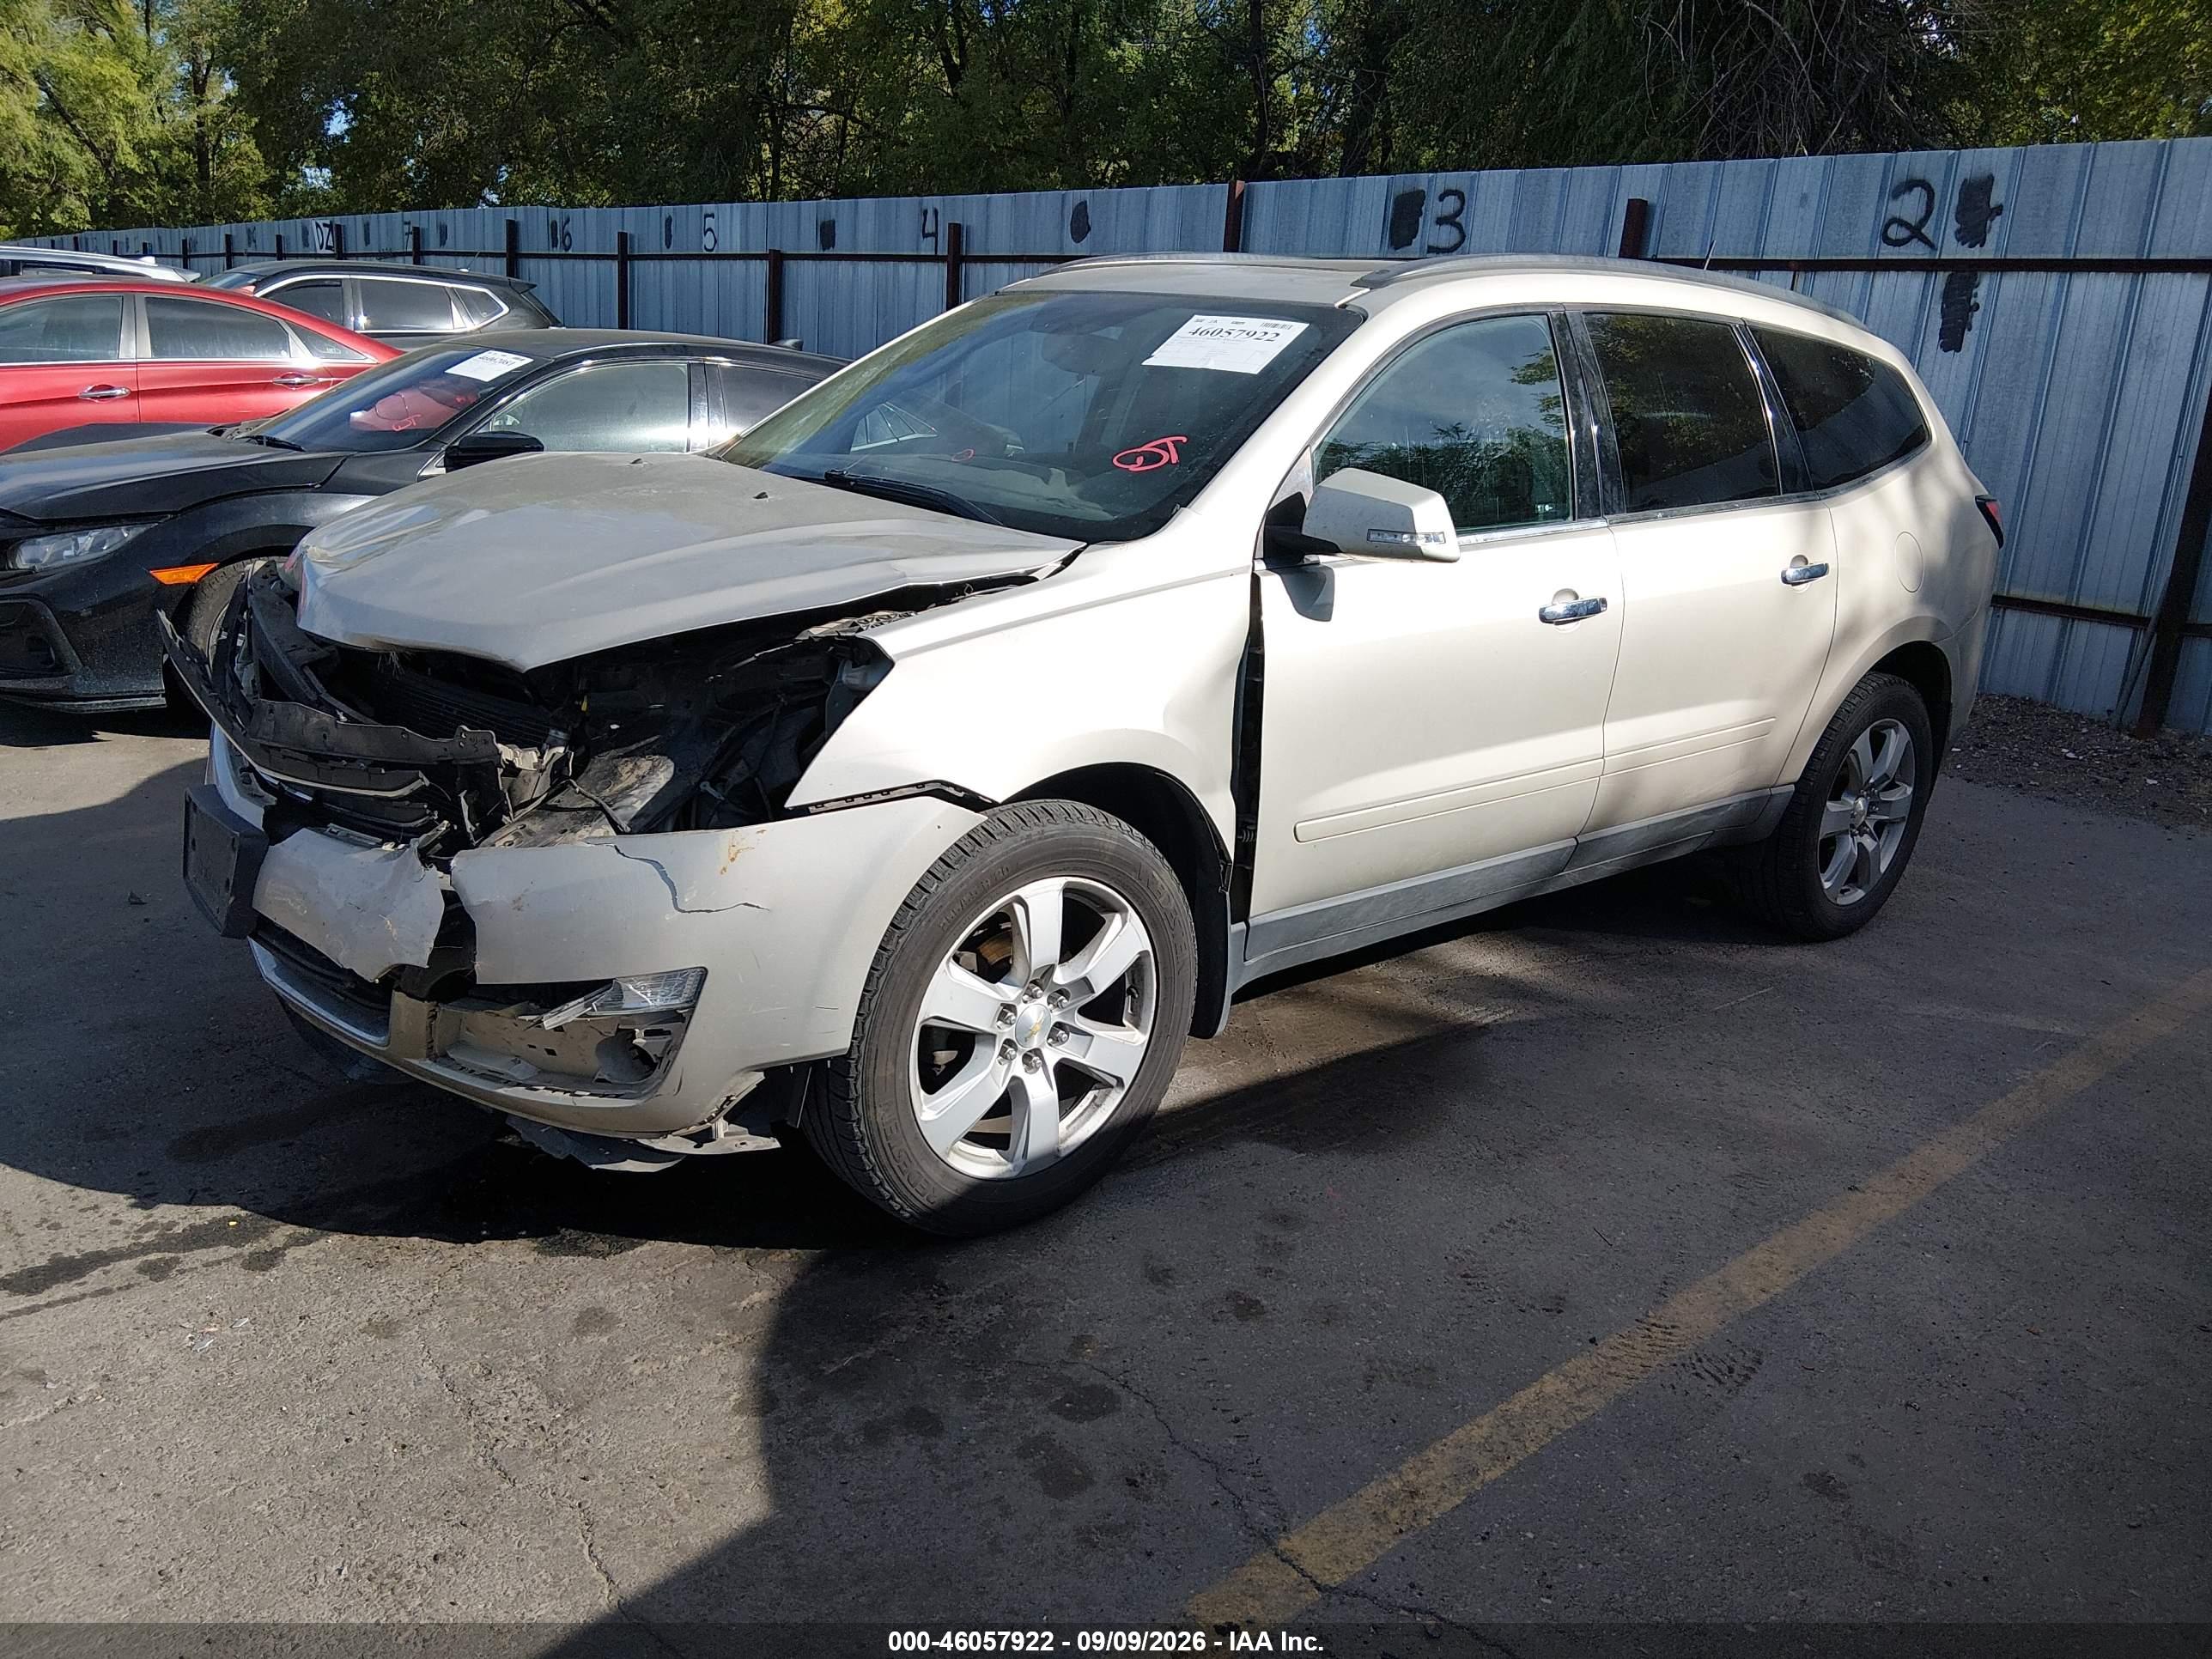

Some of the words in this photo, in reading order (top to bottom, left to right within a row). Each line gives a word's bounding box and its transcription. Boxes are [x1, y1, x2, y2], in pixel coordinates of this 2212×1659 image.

[561, 216, 573, 252] 6
[703, 213, 718, 252] 5
[921, 207, 939, 255] 4
[1427, 189, 1466, 254] 3
[1881, 179, 1937, 251] 2
[1188, 326, 1281, 342] 46057922
